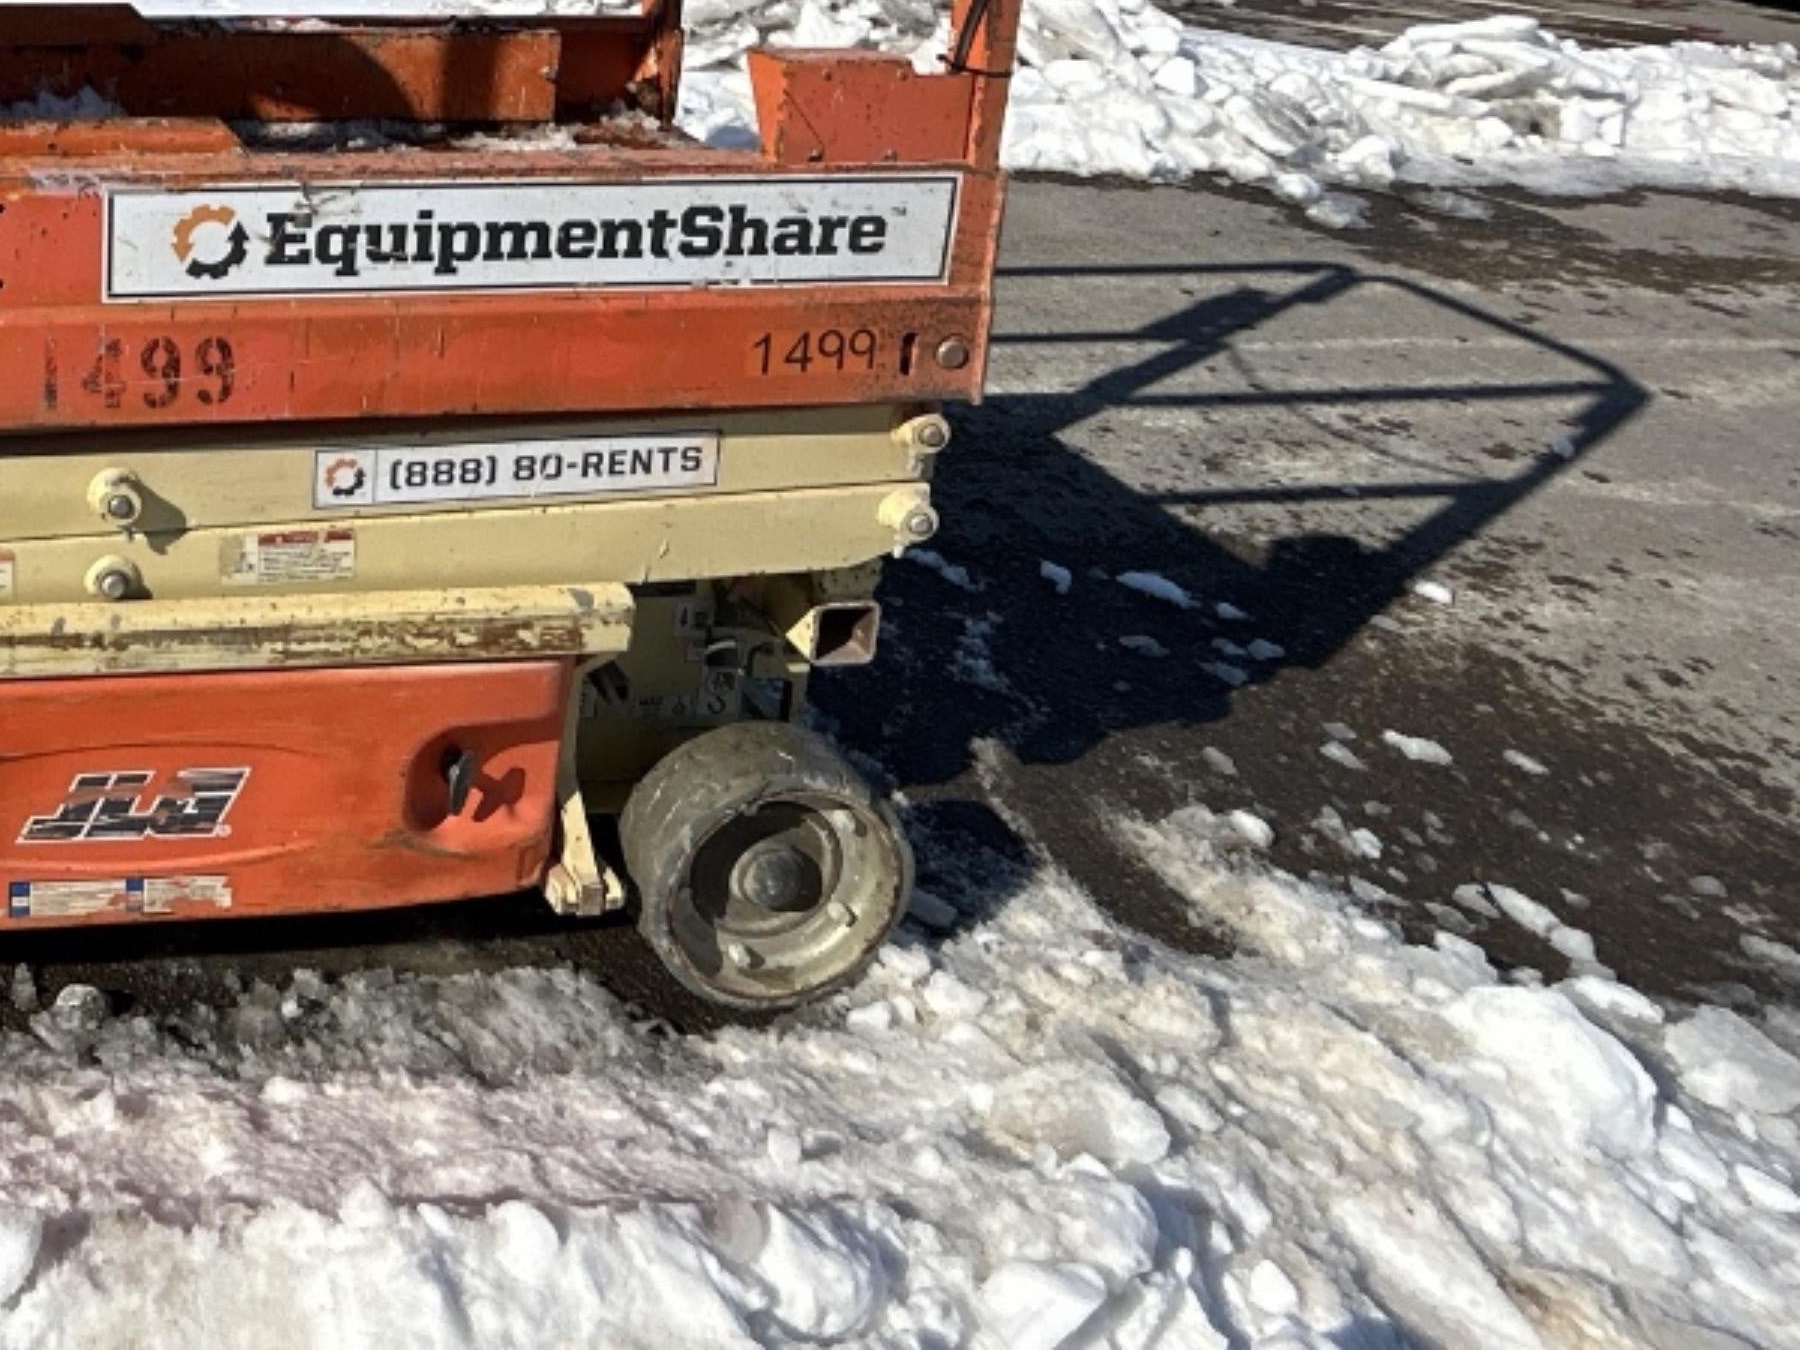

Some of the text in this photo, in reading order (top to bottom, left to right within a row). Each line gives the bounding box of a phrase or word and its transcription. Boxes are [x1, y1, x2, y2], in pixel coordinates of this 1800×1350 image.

[265, 204, 888, 277] EquipmentShare
[43, 335, 235, 410] 1499
[753, 329, 877, 376] 1499
[389, 446, 703, 490] (888) 80-RENTS
